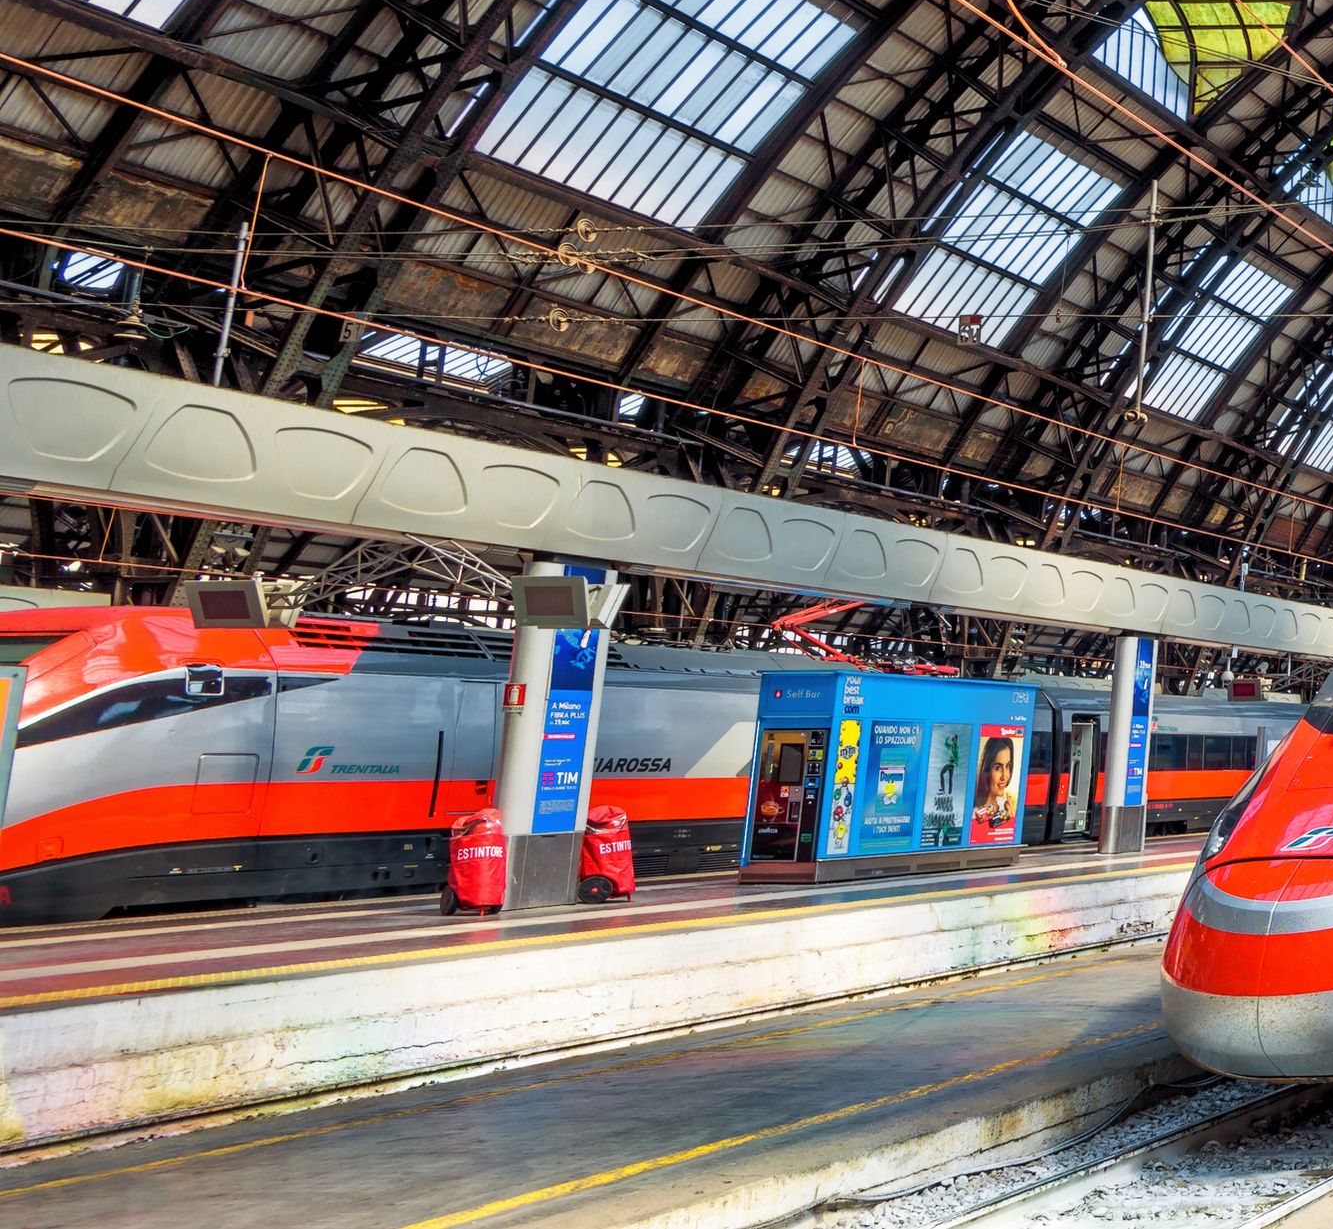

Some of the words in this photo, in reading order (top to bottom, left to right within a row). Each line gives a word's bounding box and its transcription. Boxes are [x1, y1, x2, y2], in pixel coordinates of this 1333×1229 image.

[787, 690, 804, 699] Self
[806, 689, 821, 698] Bar
[874, 725, 898, 734] QUANDO
[331, 764, 400, 774] TRENITALIA
[593, 758, 671, 772] IAROSSA
[556, 771, 578, 785] TIM
[457, 846, 504, 860] ESTINTORE
